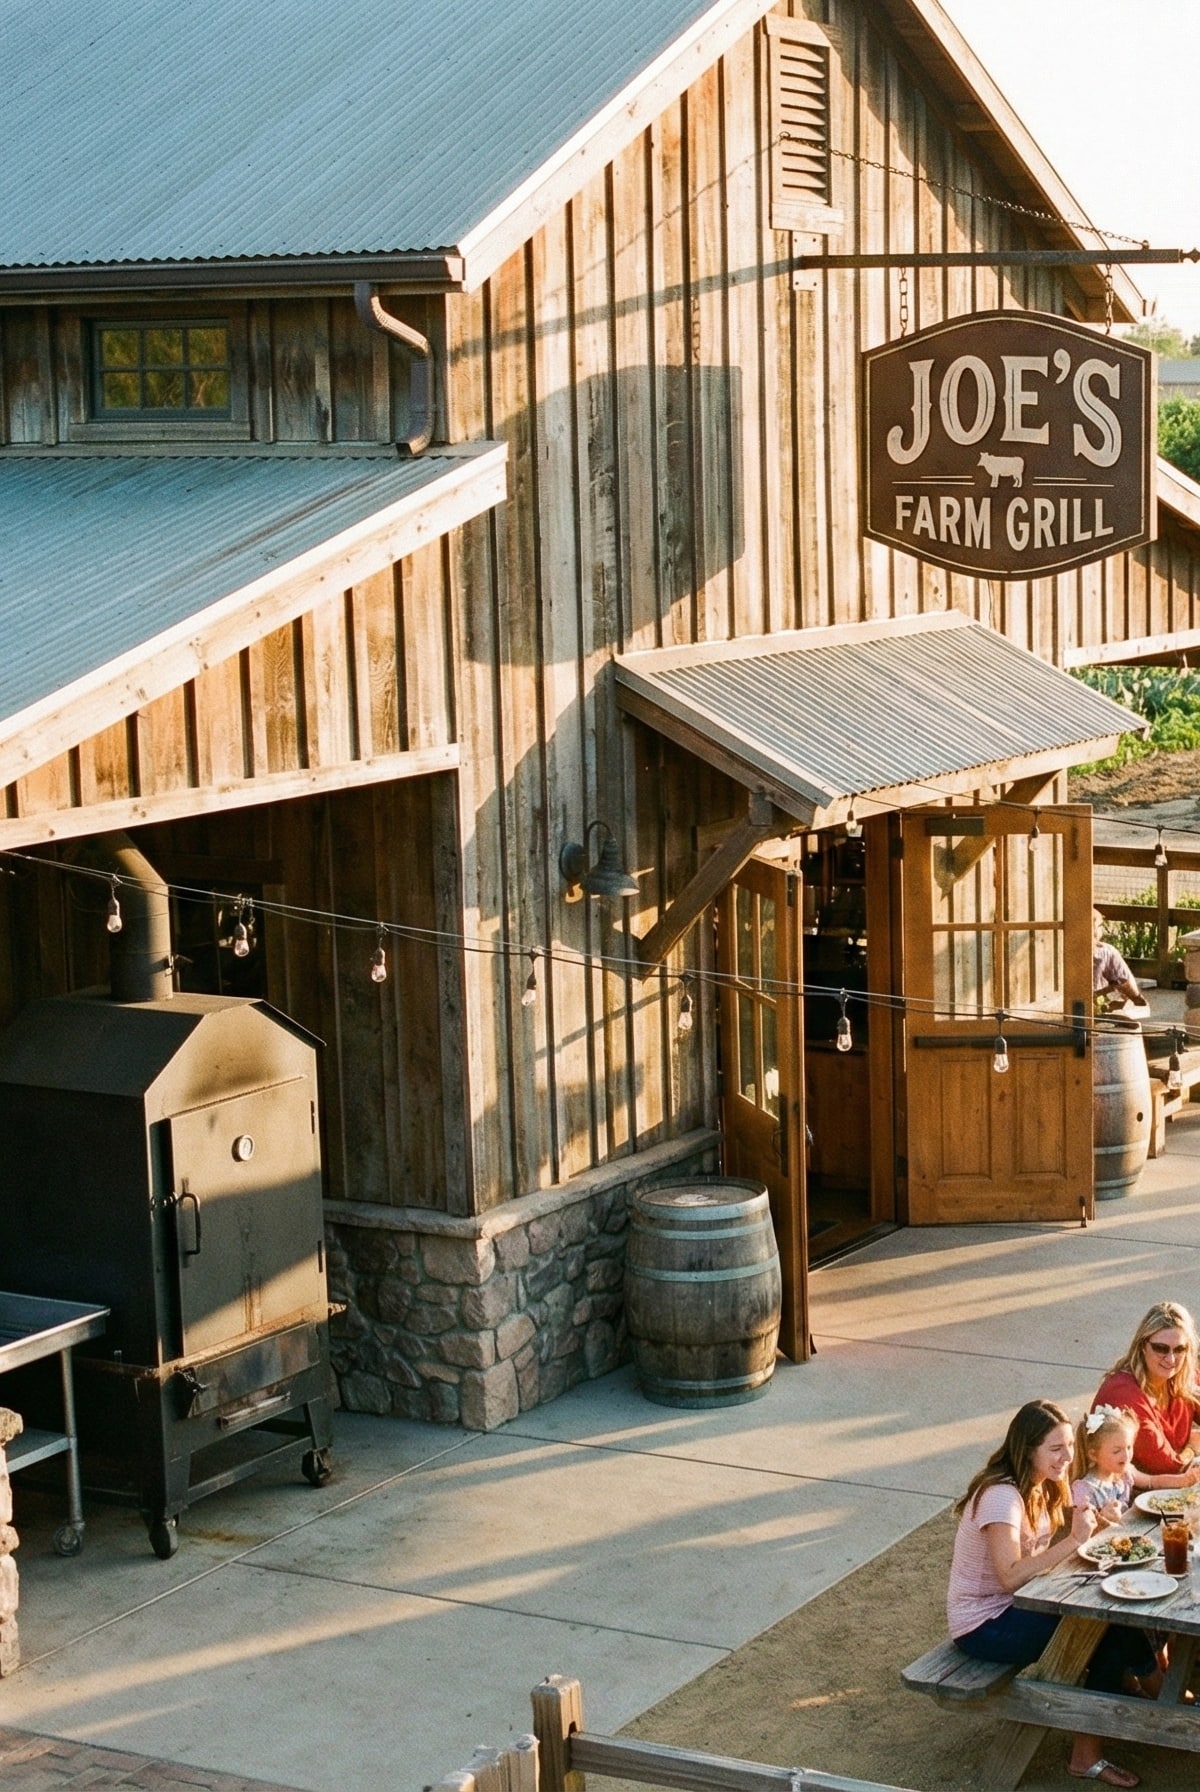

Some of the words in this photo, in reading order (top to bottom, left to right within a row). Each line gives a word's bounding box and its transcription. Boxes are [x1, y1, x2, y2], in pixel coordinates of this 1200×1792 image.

[887, 348, 1122, 467] JOE’S
[895, 495, 991, 550] FARM
[1006, 496, 1114, 551] GRILL
